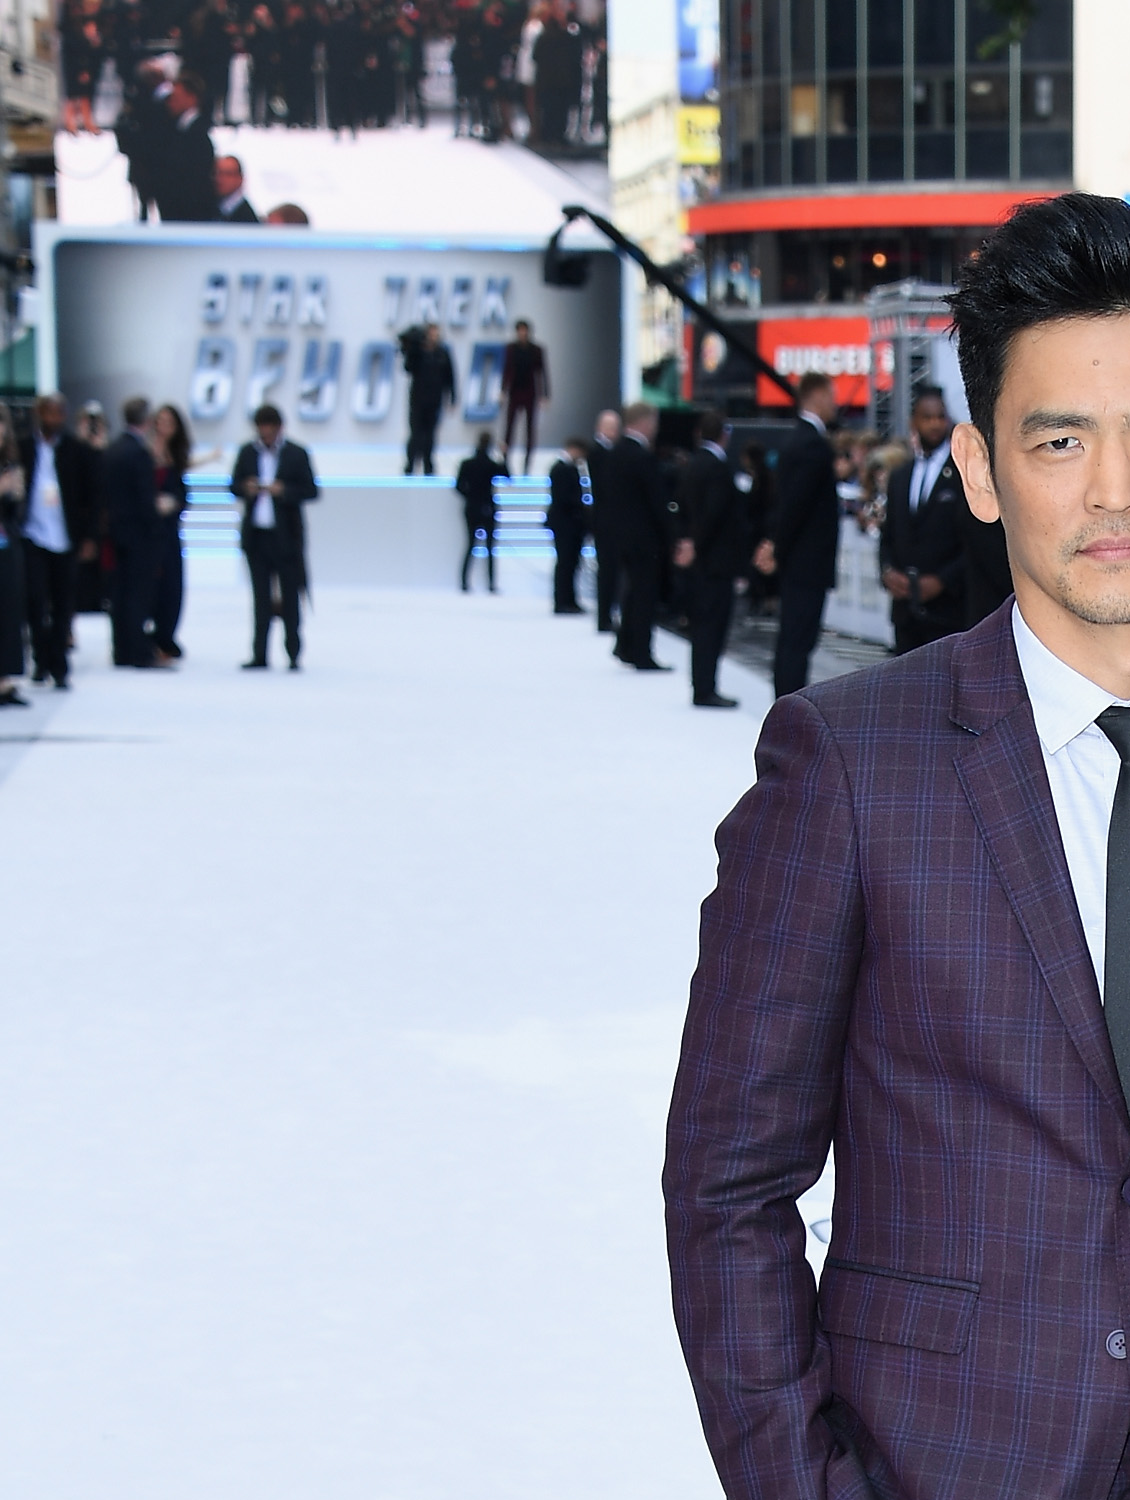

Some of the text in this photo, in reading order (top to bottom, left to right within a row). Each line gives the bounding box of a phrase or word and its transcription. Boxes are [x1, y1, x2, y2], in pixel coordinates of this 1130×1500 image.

[201, 272, 510, 328] STAR TREK
[190, 336, 507, 422] BEYOD
